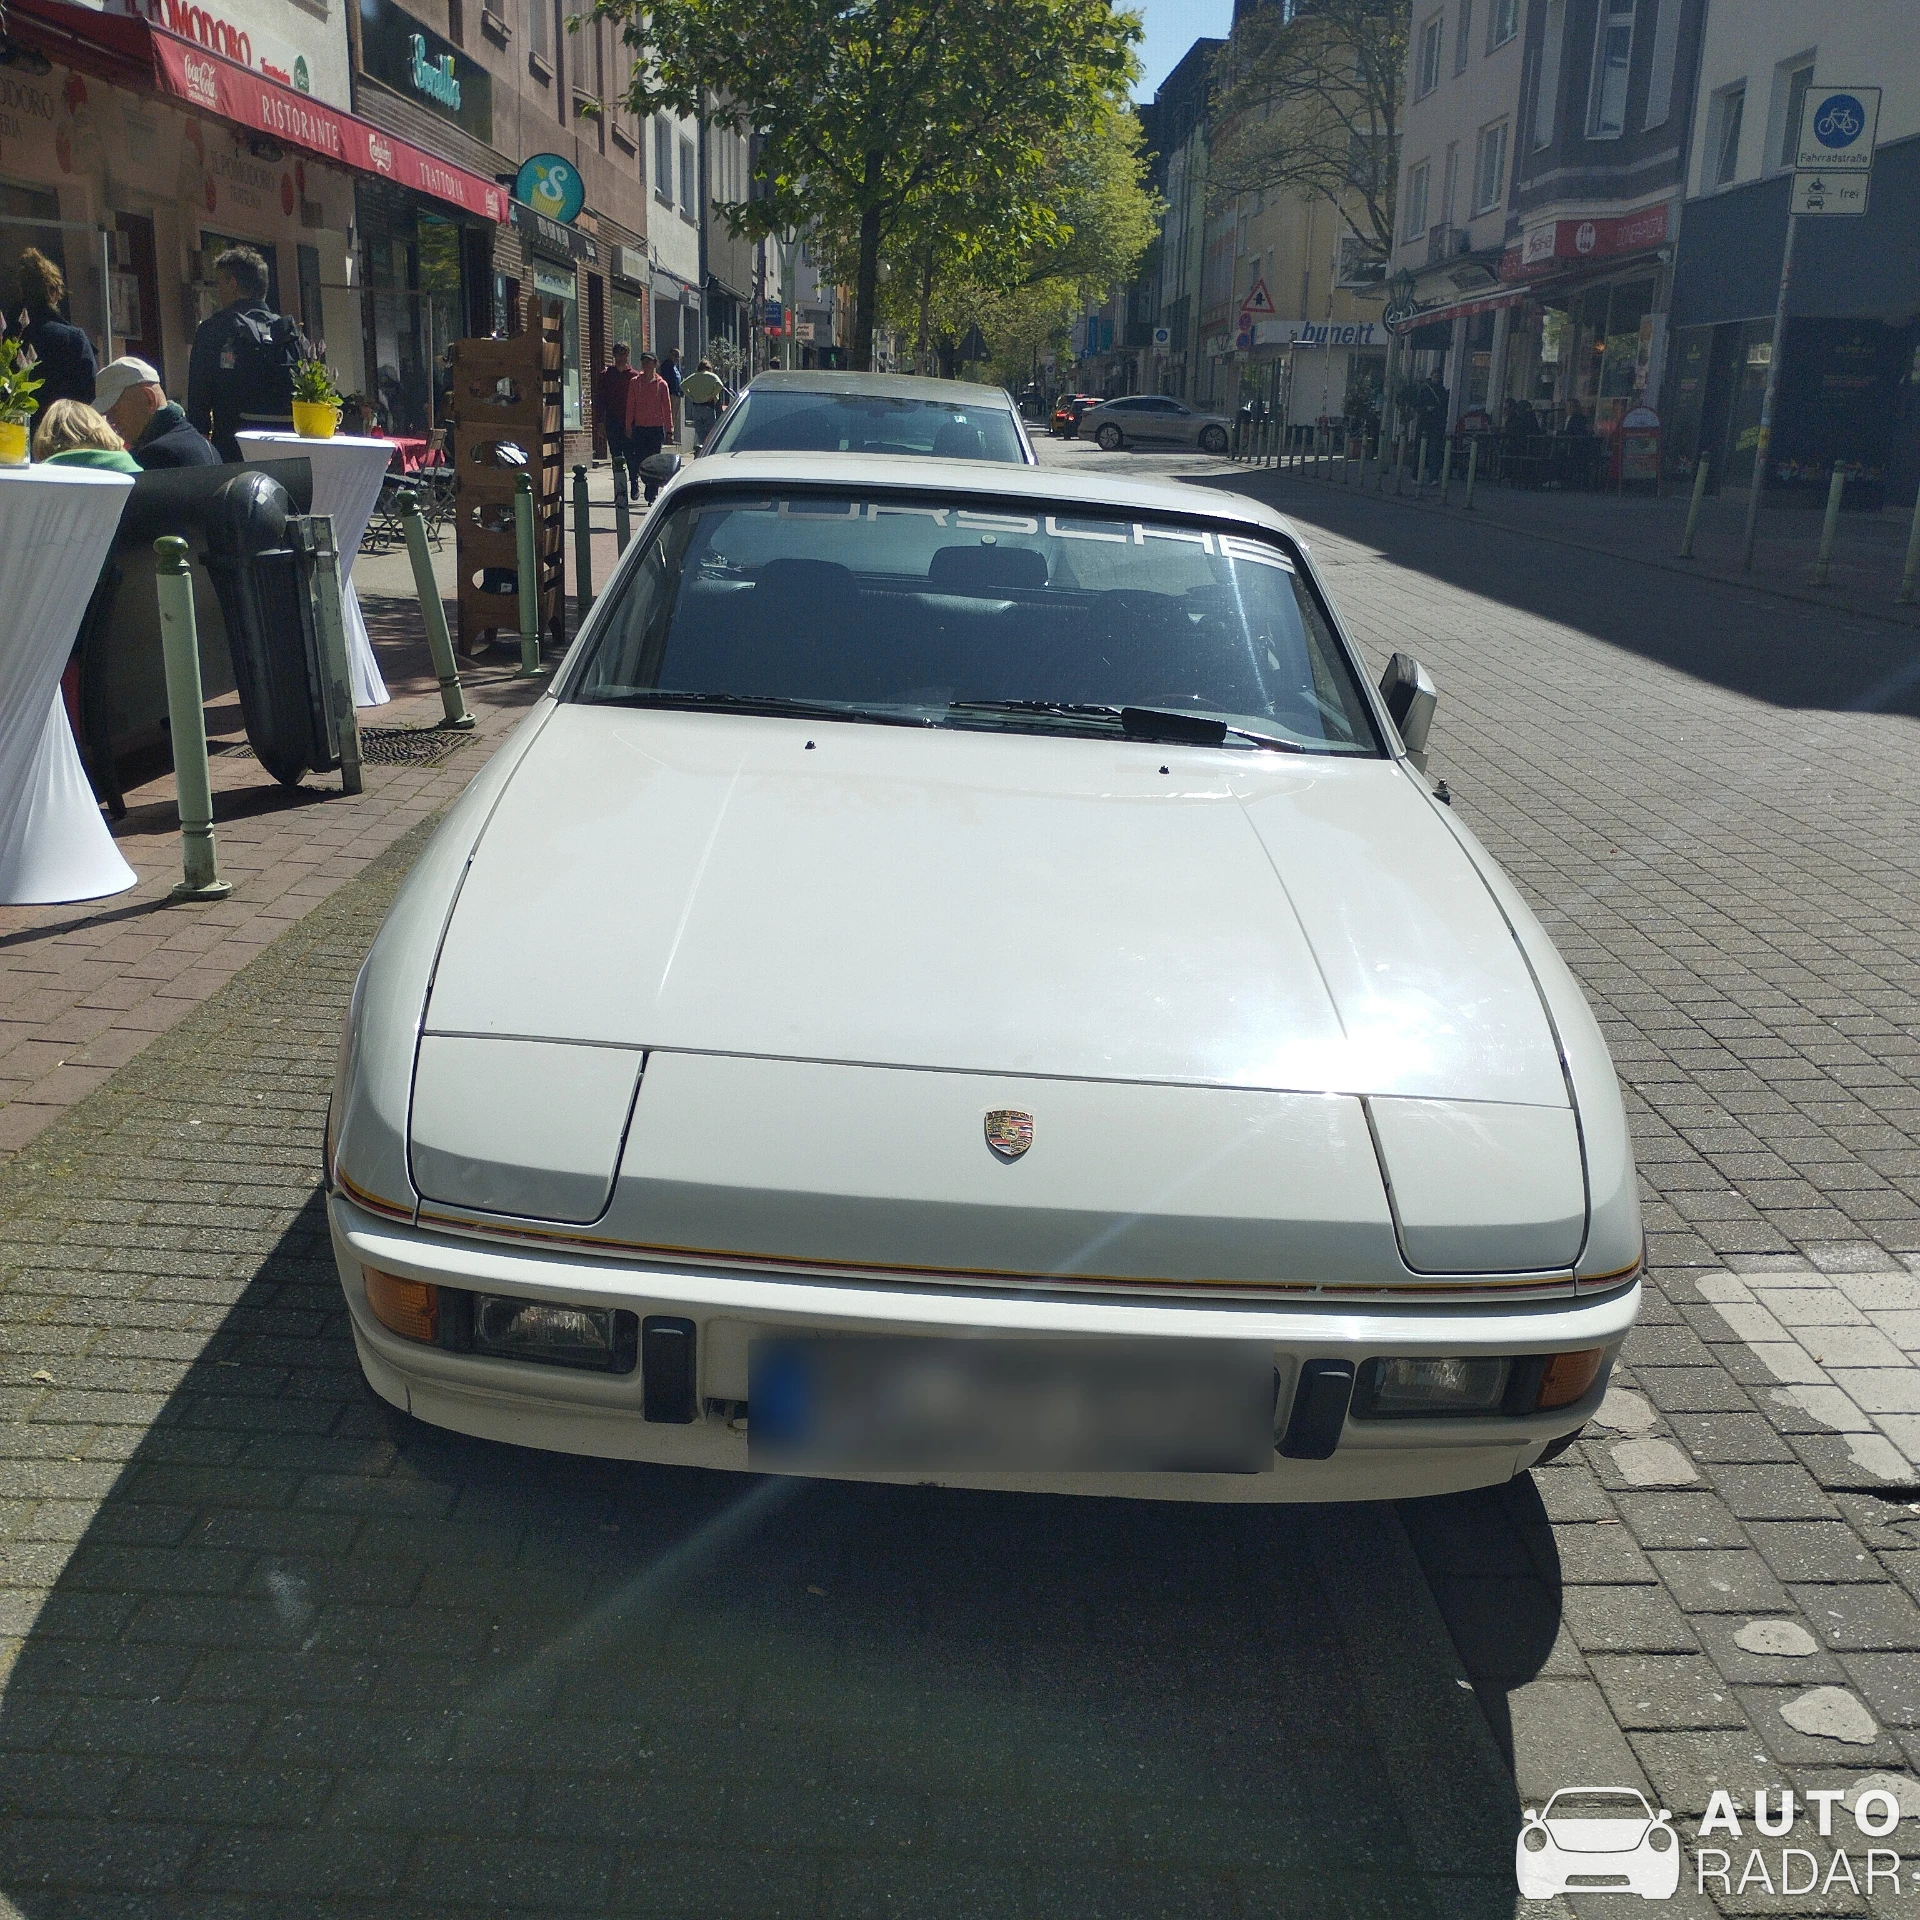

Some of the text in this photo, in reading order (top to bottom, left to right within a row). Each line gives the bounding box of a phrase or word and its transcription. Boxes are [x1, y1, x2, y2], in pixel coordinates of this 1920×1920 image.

[262, 95, 339, 152] RISTORANTE
[1800, 153, 1868, 163] Fahrradstraße
[419, 162, 465, 202] TRATTORIA
[539, 165, 568, 201] S
[1840, 188, 1860, 199] frei
